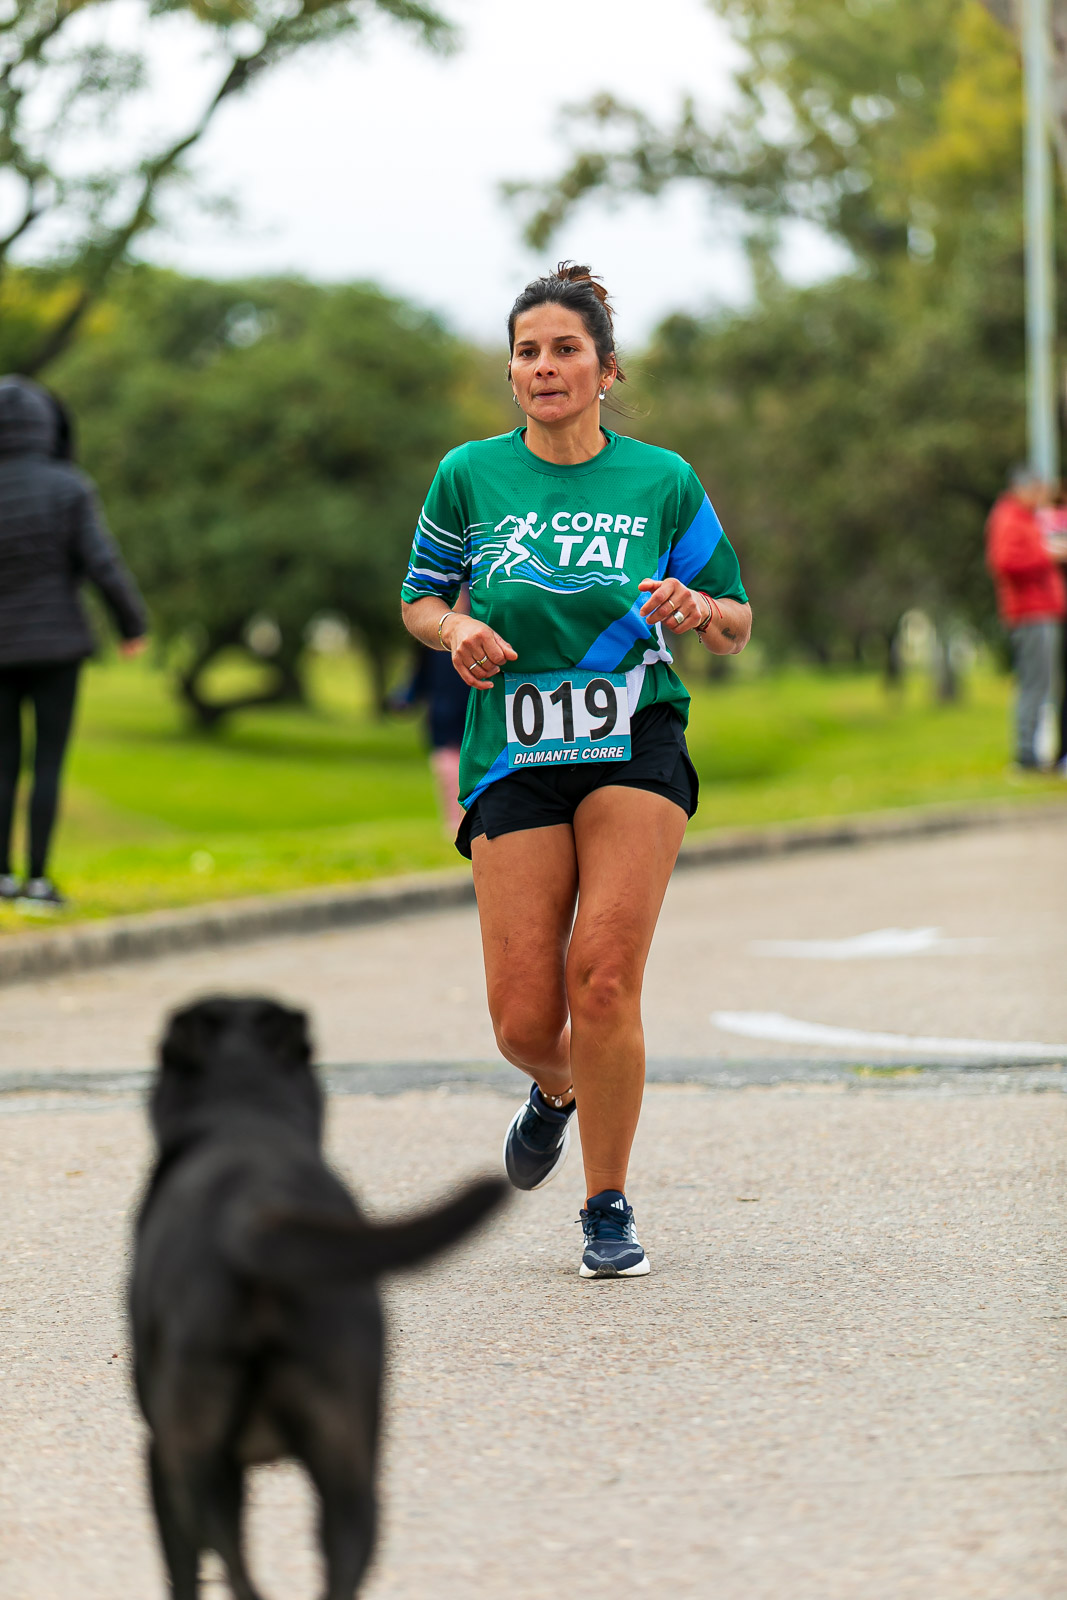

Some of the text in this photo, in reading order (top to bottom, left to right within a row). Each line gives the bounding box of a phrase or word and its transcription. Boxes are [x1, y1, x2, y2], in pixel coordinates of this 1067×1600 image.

[551, 511, 648, 537] CORRE
[553, 535, 628, 569] TAI
[513, 677, 618, 748] 019
[513, 746, 625, 765] DIAMANTE CORRE
